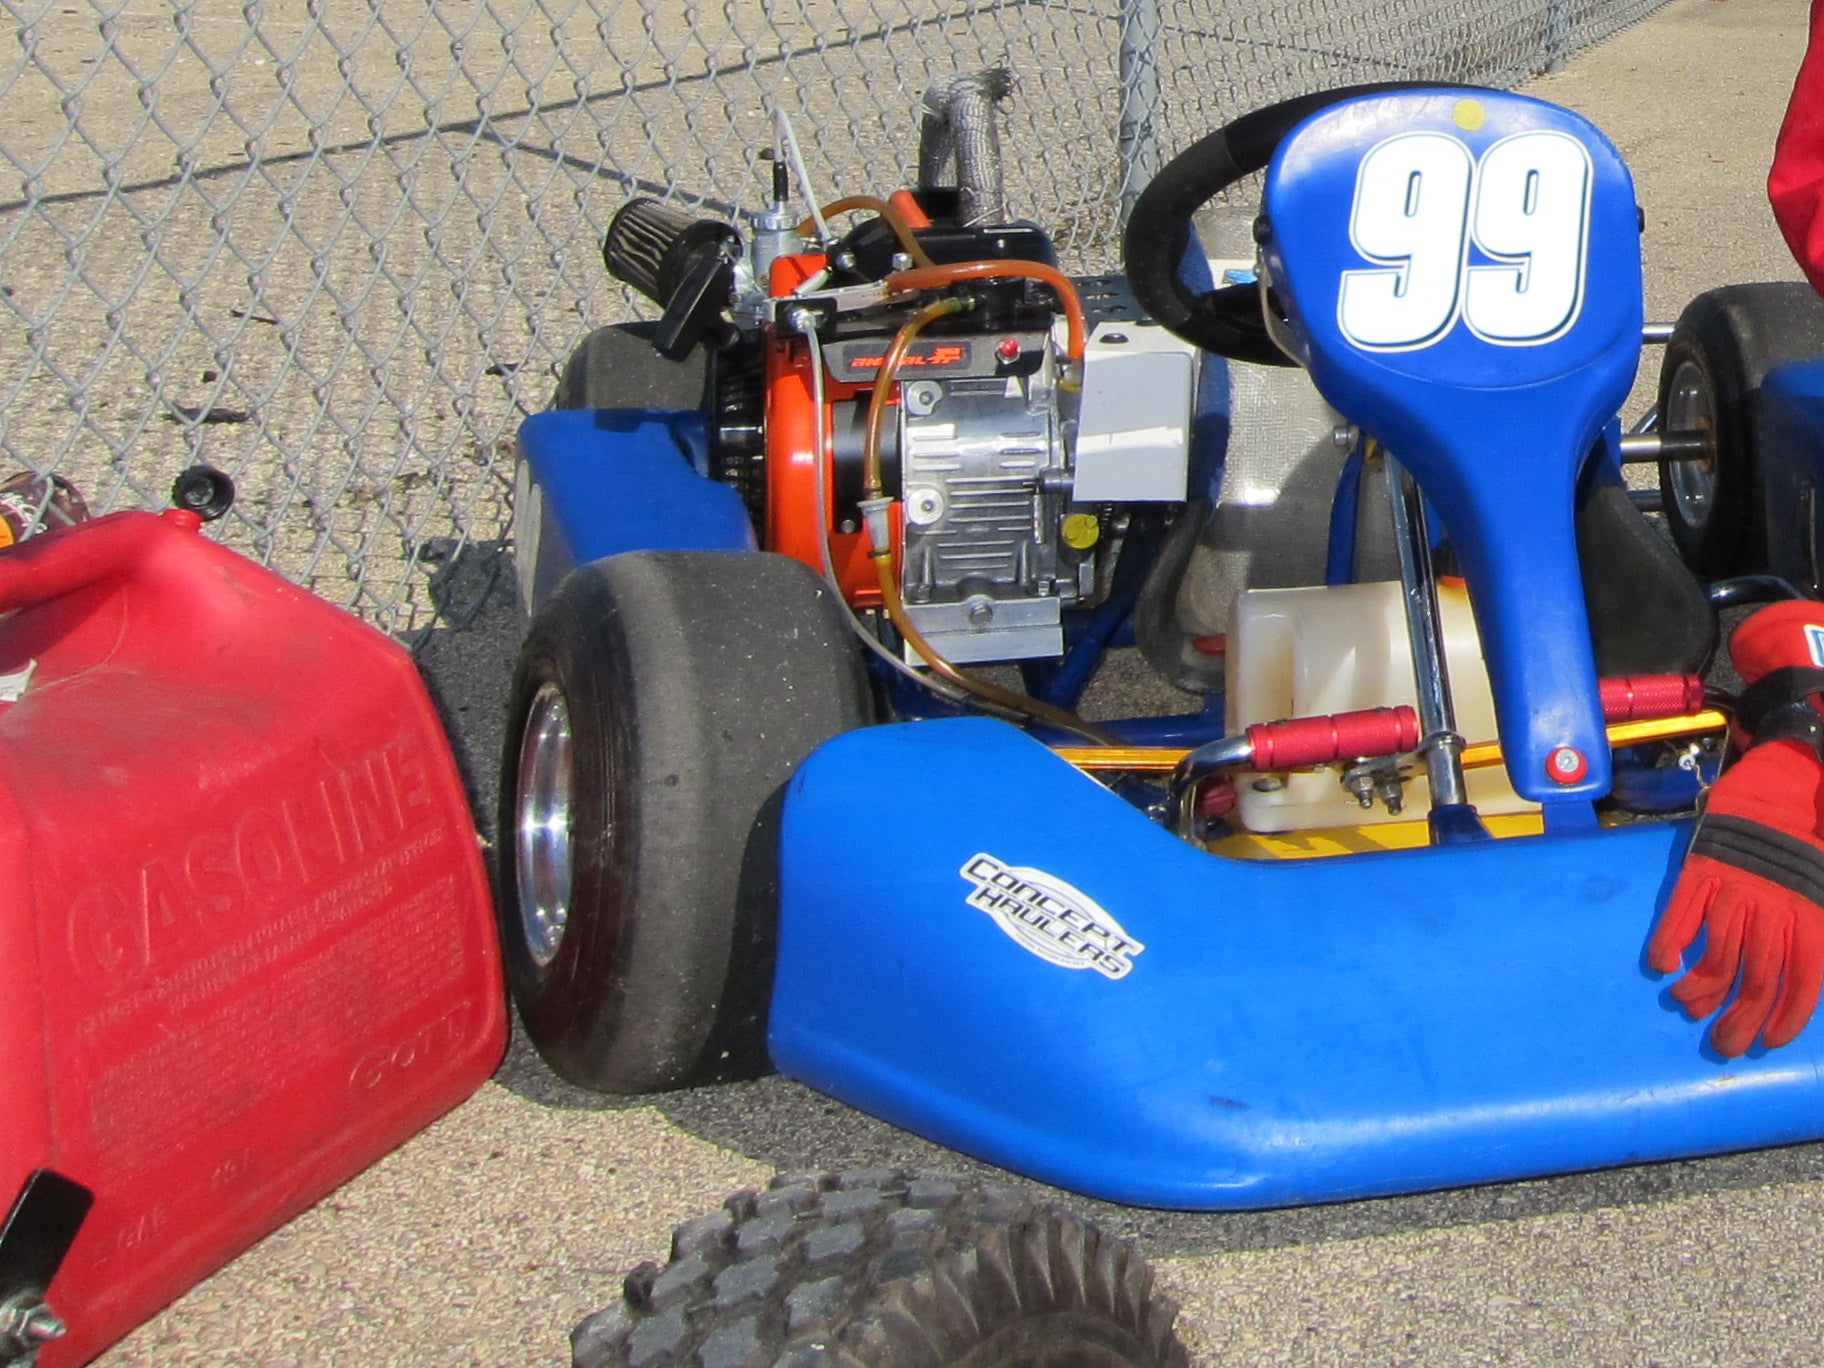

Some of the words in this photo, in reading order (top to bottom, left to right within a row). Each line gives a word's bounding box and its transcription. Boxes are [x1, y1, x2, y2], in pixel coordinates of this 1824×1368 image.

[1336, 129, 1594, 353] 99
[67, 735, 437, 994] GASOLINE
[966, 858, 1138, 953] CONCEPT
[975, 887, 1126, 974] HAULERS
